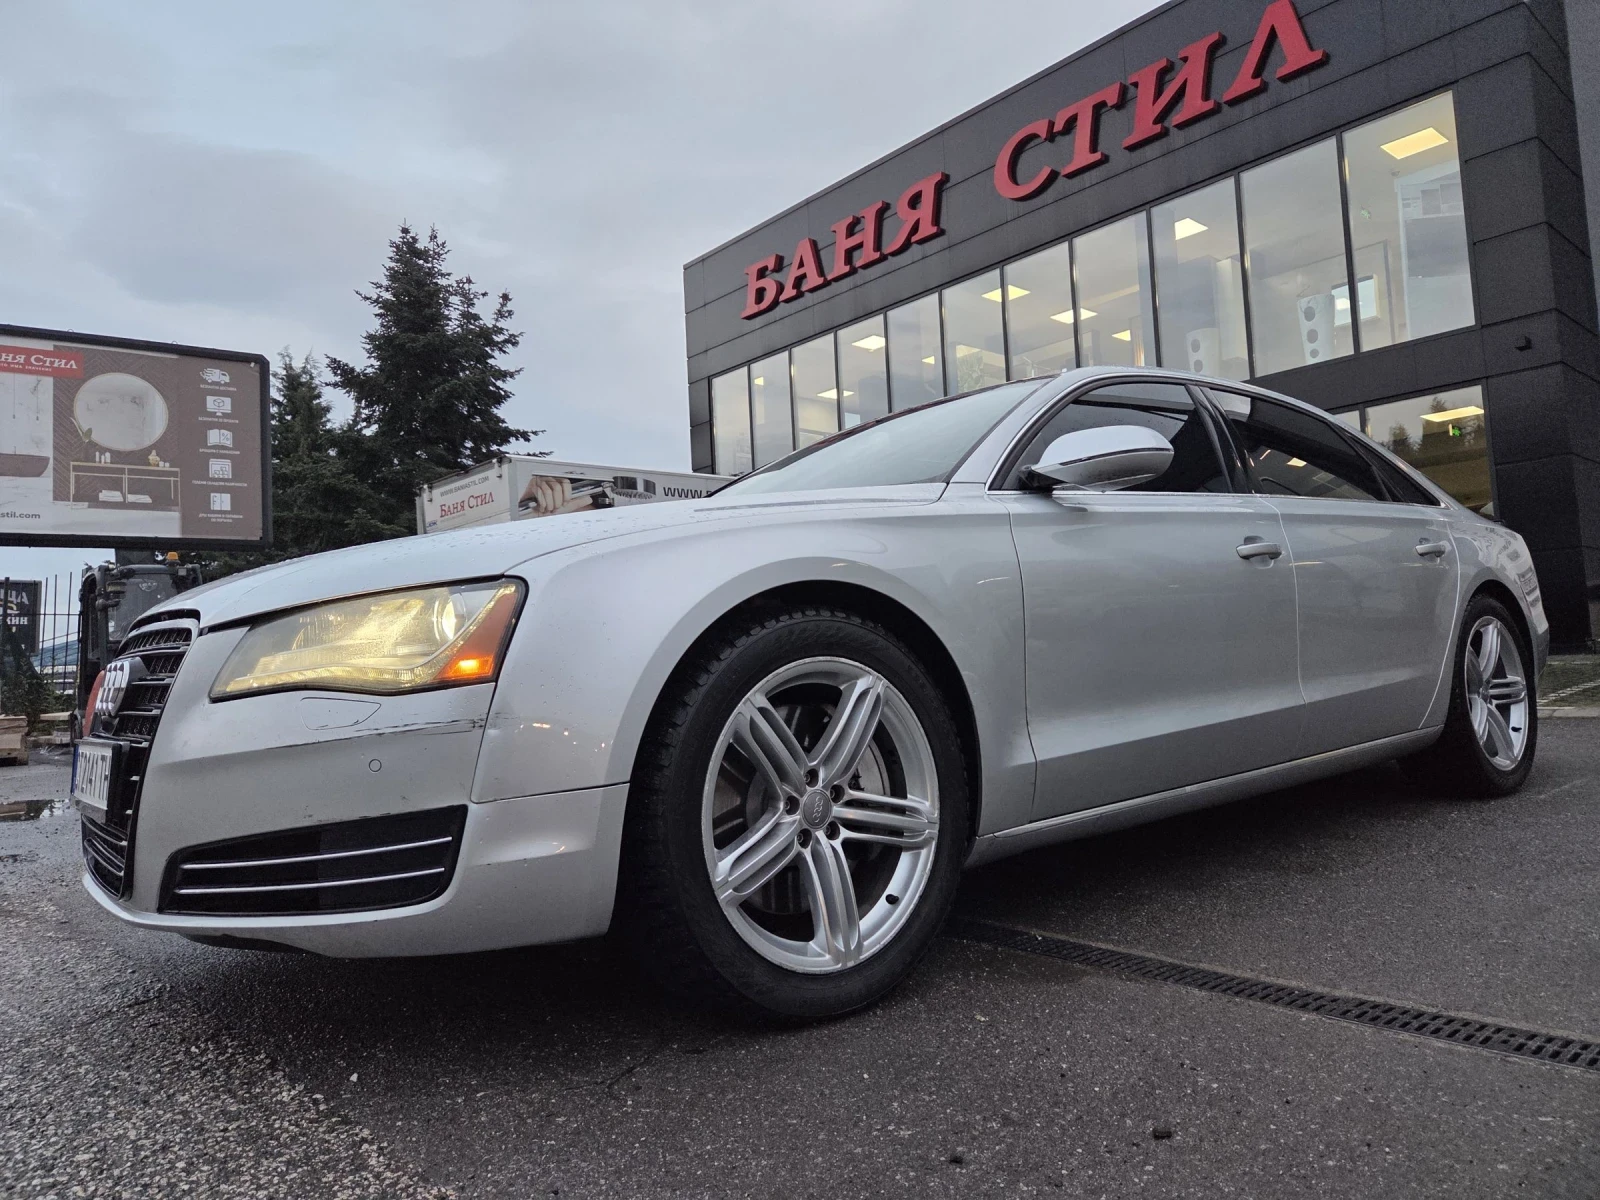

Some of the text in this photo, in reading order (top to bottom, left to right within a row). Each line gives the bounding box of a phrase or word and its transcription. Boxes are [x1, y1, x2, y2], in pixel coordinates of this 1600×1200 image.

[740, 0, 1330, 320] БАНЯ СТИЛ
[0, 353, 26, 364] НЯ
